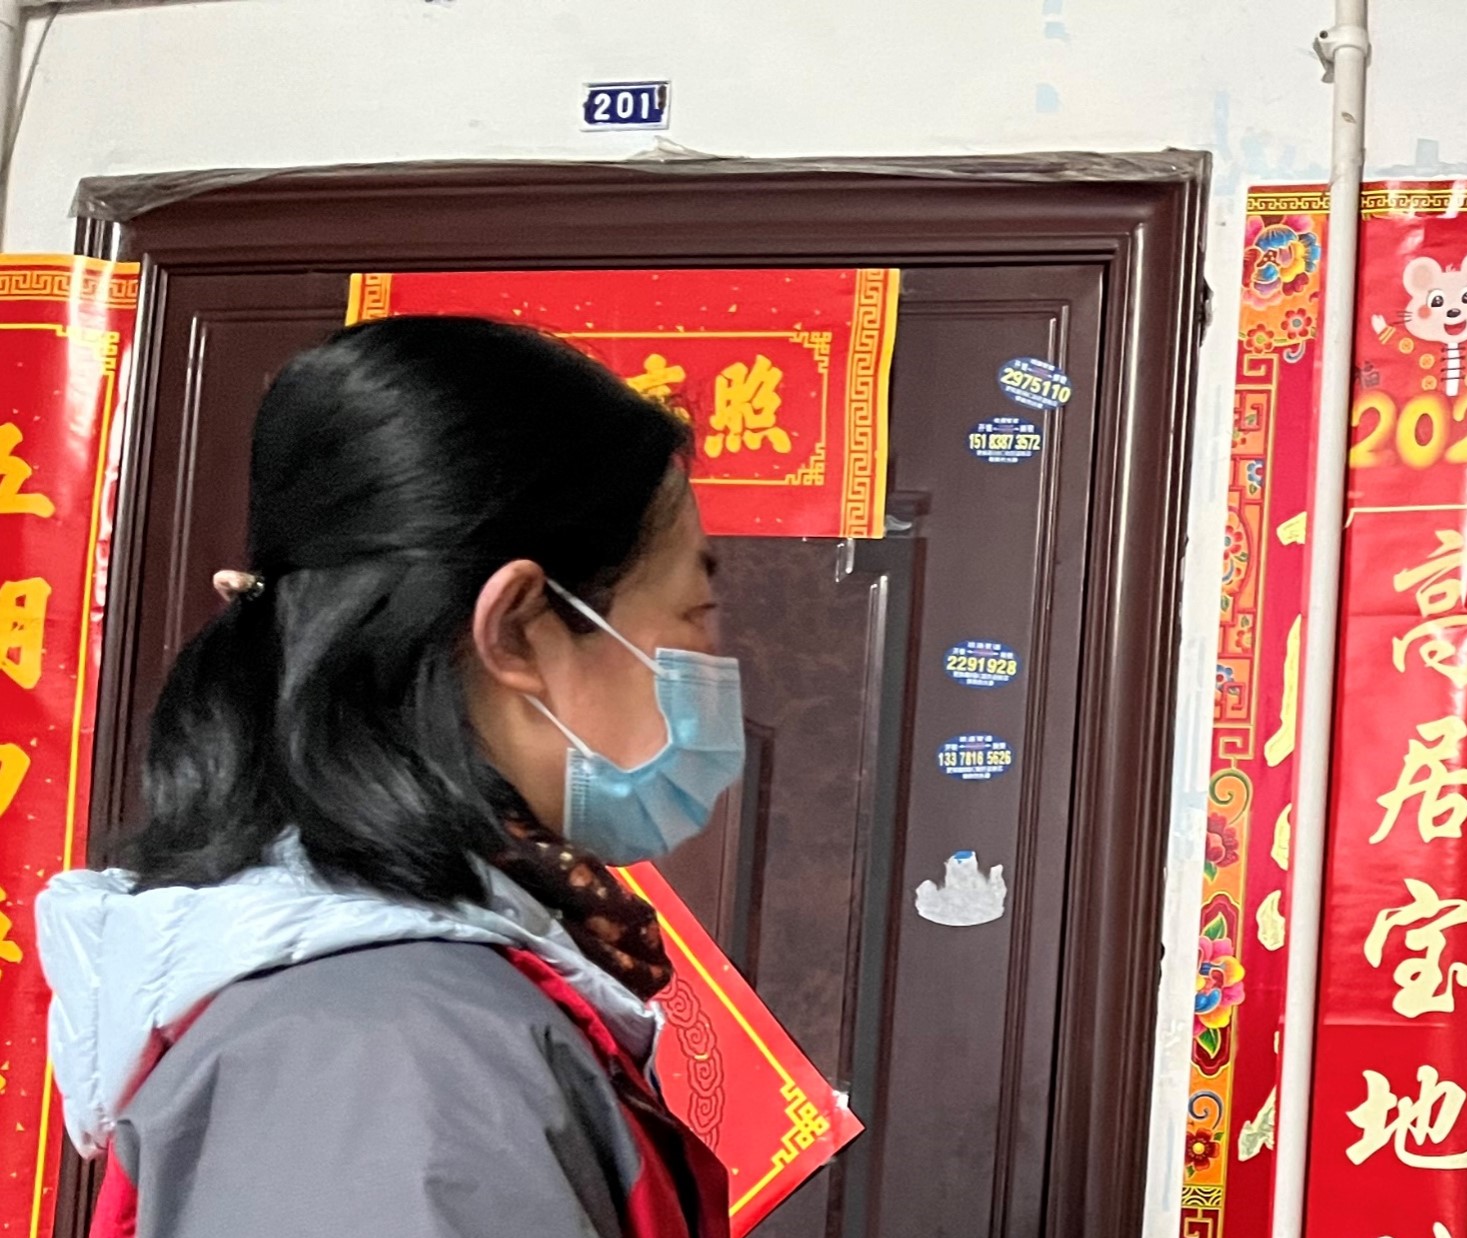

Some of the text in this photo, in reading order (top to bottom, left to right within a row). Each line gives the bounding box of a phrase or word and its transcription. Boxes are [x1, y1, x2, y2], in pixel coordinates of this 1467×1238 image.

[594, 92, 651, 121] 201
[1000, 367, 1071, 403] 2975110
[969, 433, 986, 450] 151
[946, 655, 1017, 676] 2291928
